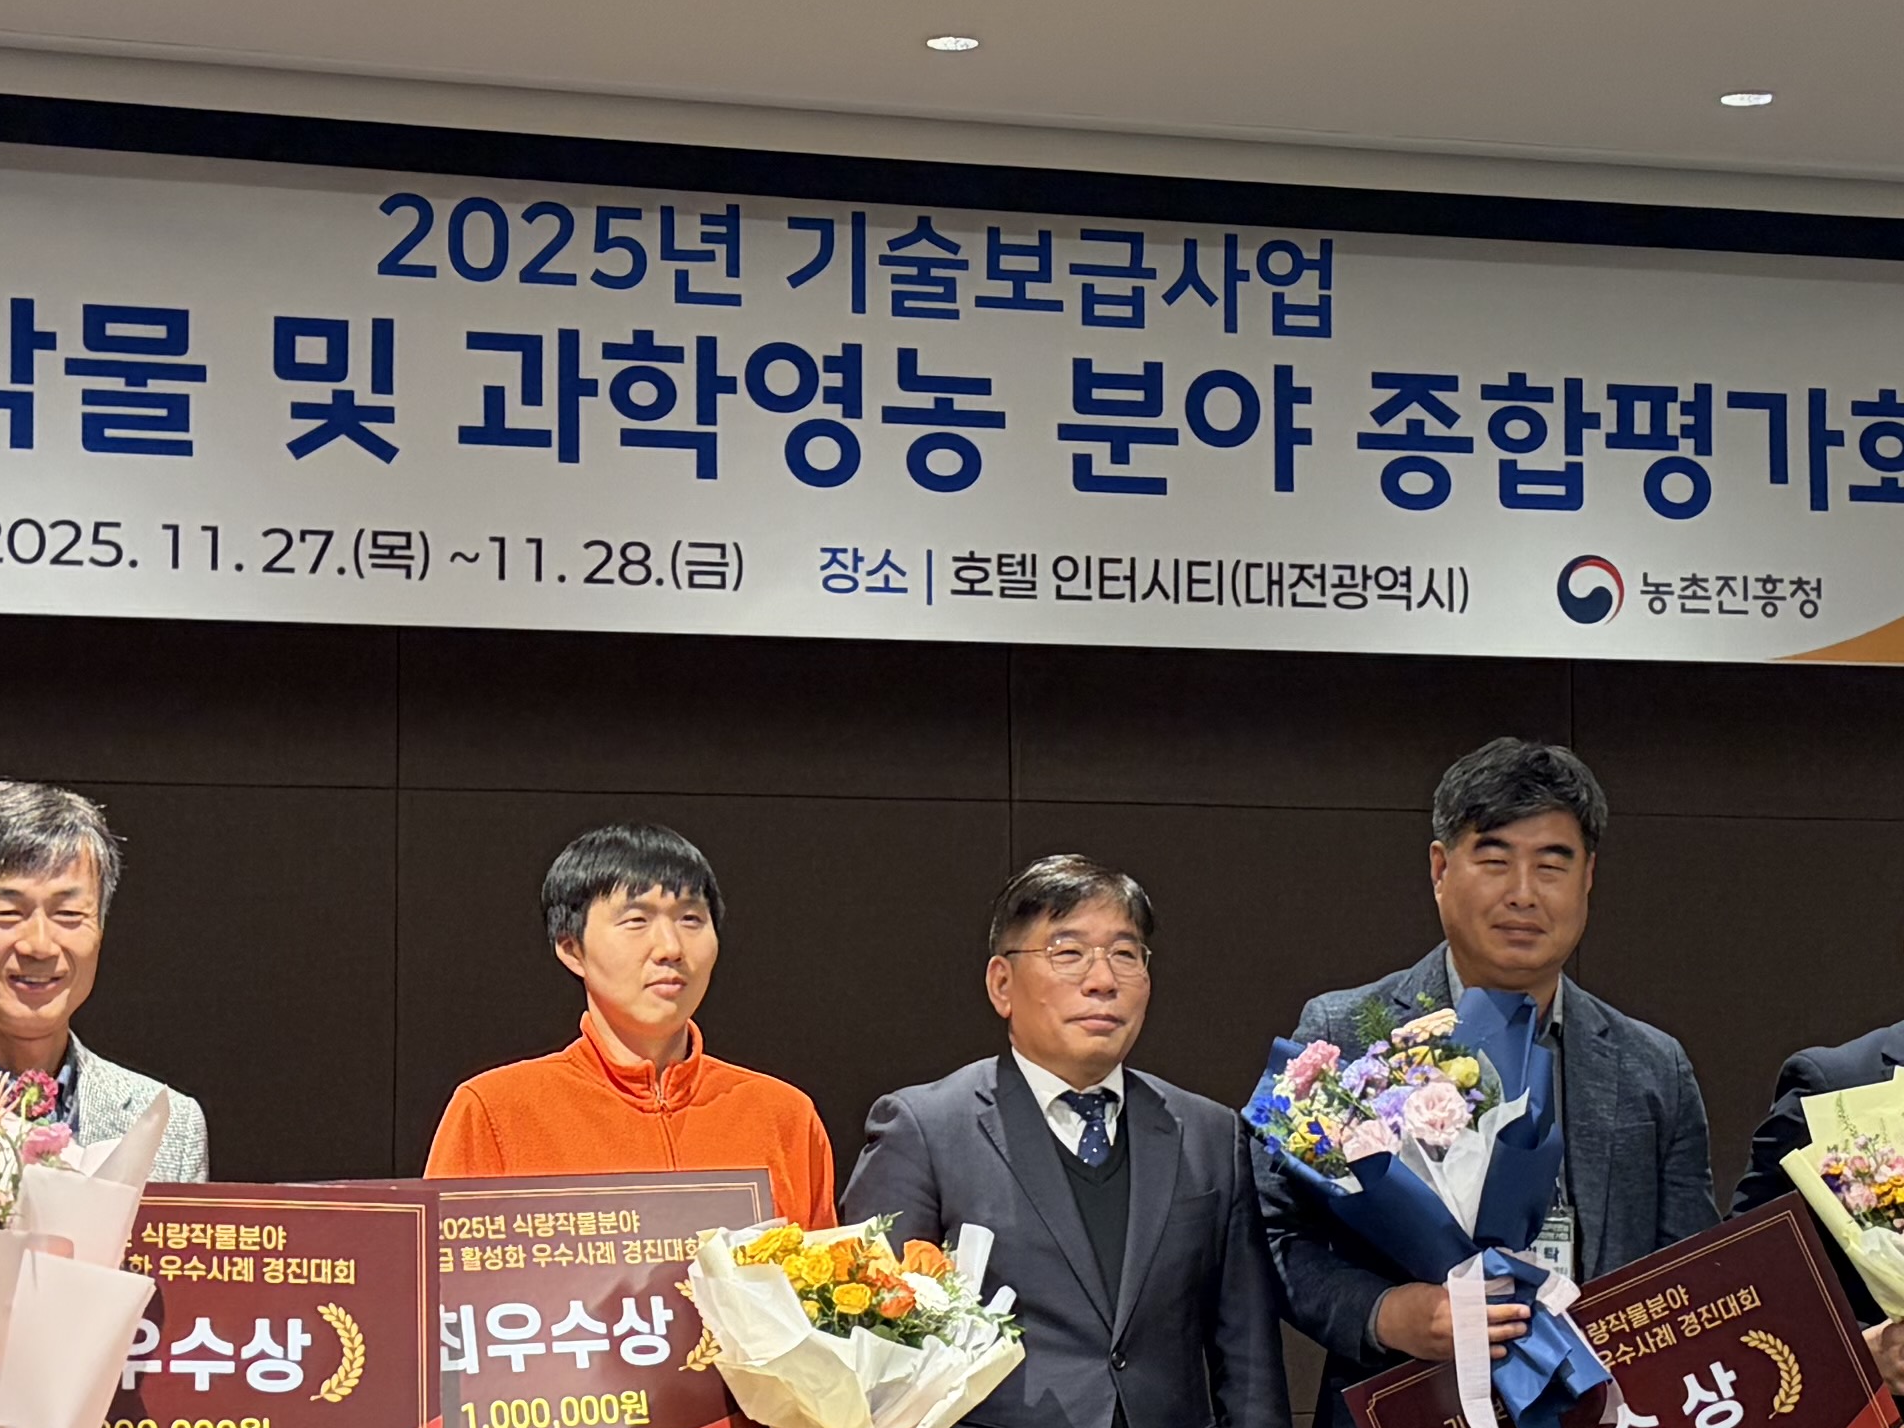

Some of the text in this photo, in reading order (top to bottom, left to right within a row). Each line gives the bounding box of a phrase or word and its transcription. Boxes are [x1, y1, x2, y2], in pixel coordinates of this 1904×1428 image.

[377, 192, 1334, 339] 2025년 기술보급사업
[272, 315, 401, 465] 및
[457, 326, 1007, 493] 과학영농
[1057, 357, 1314, 496] 분야
[161, 522, 244, 573] 11.
[818, 546, 909, 595] 장소
[949, 549, 1038, 600] 호텔
[1050, 554, 1470, 614] 인터시티(대전광역시)
[1639, 571, 1823, 619] 농촌진흥청
[141, 1221, 288, 1252] 식량작물분야
[439, 1209, 641, 1241] 025년 식량작물분야
[158, 1255, 255, 1283] 우수사례
[262, 1257, 357, 1285] 경진대회
[460, 1245, 527, 1273] 활성화
[532, 1240, 617, 1269] 우수사례
[1584, 1284, 1690, 1346] 량작물분야
[1677, 1284, 1762, 1339] 경진대회
